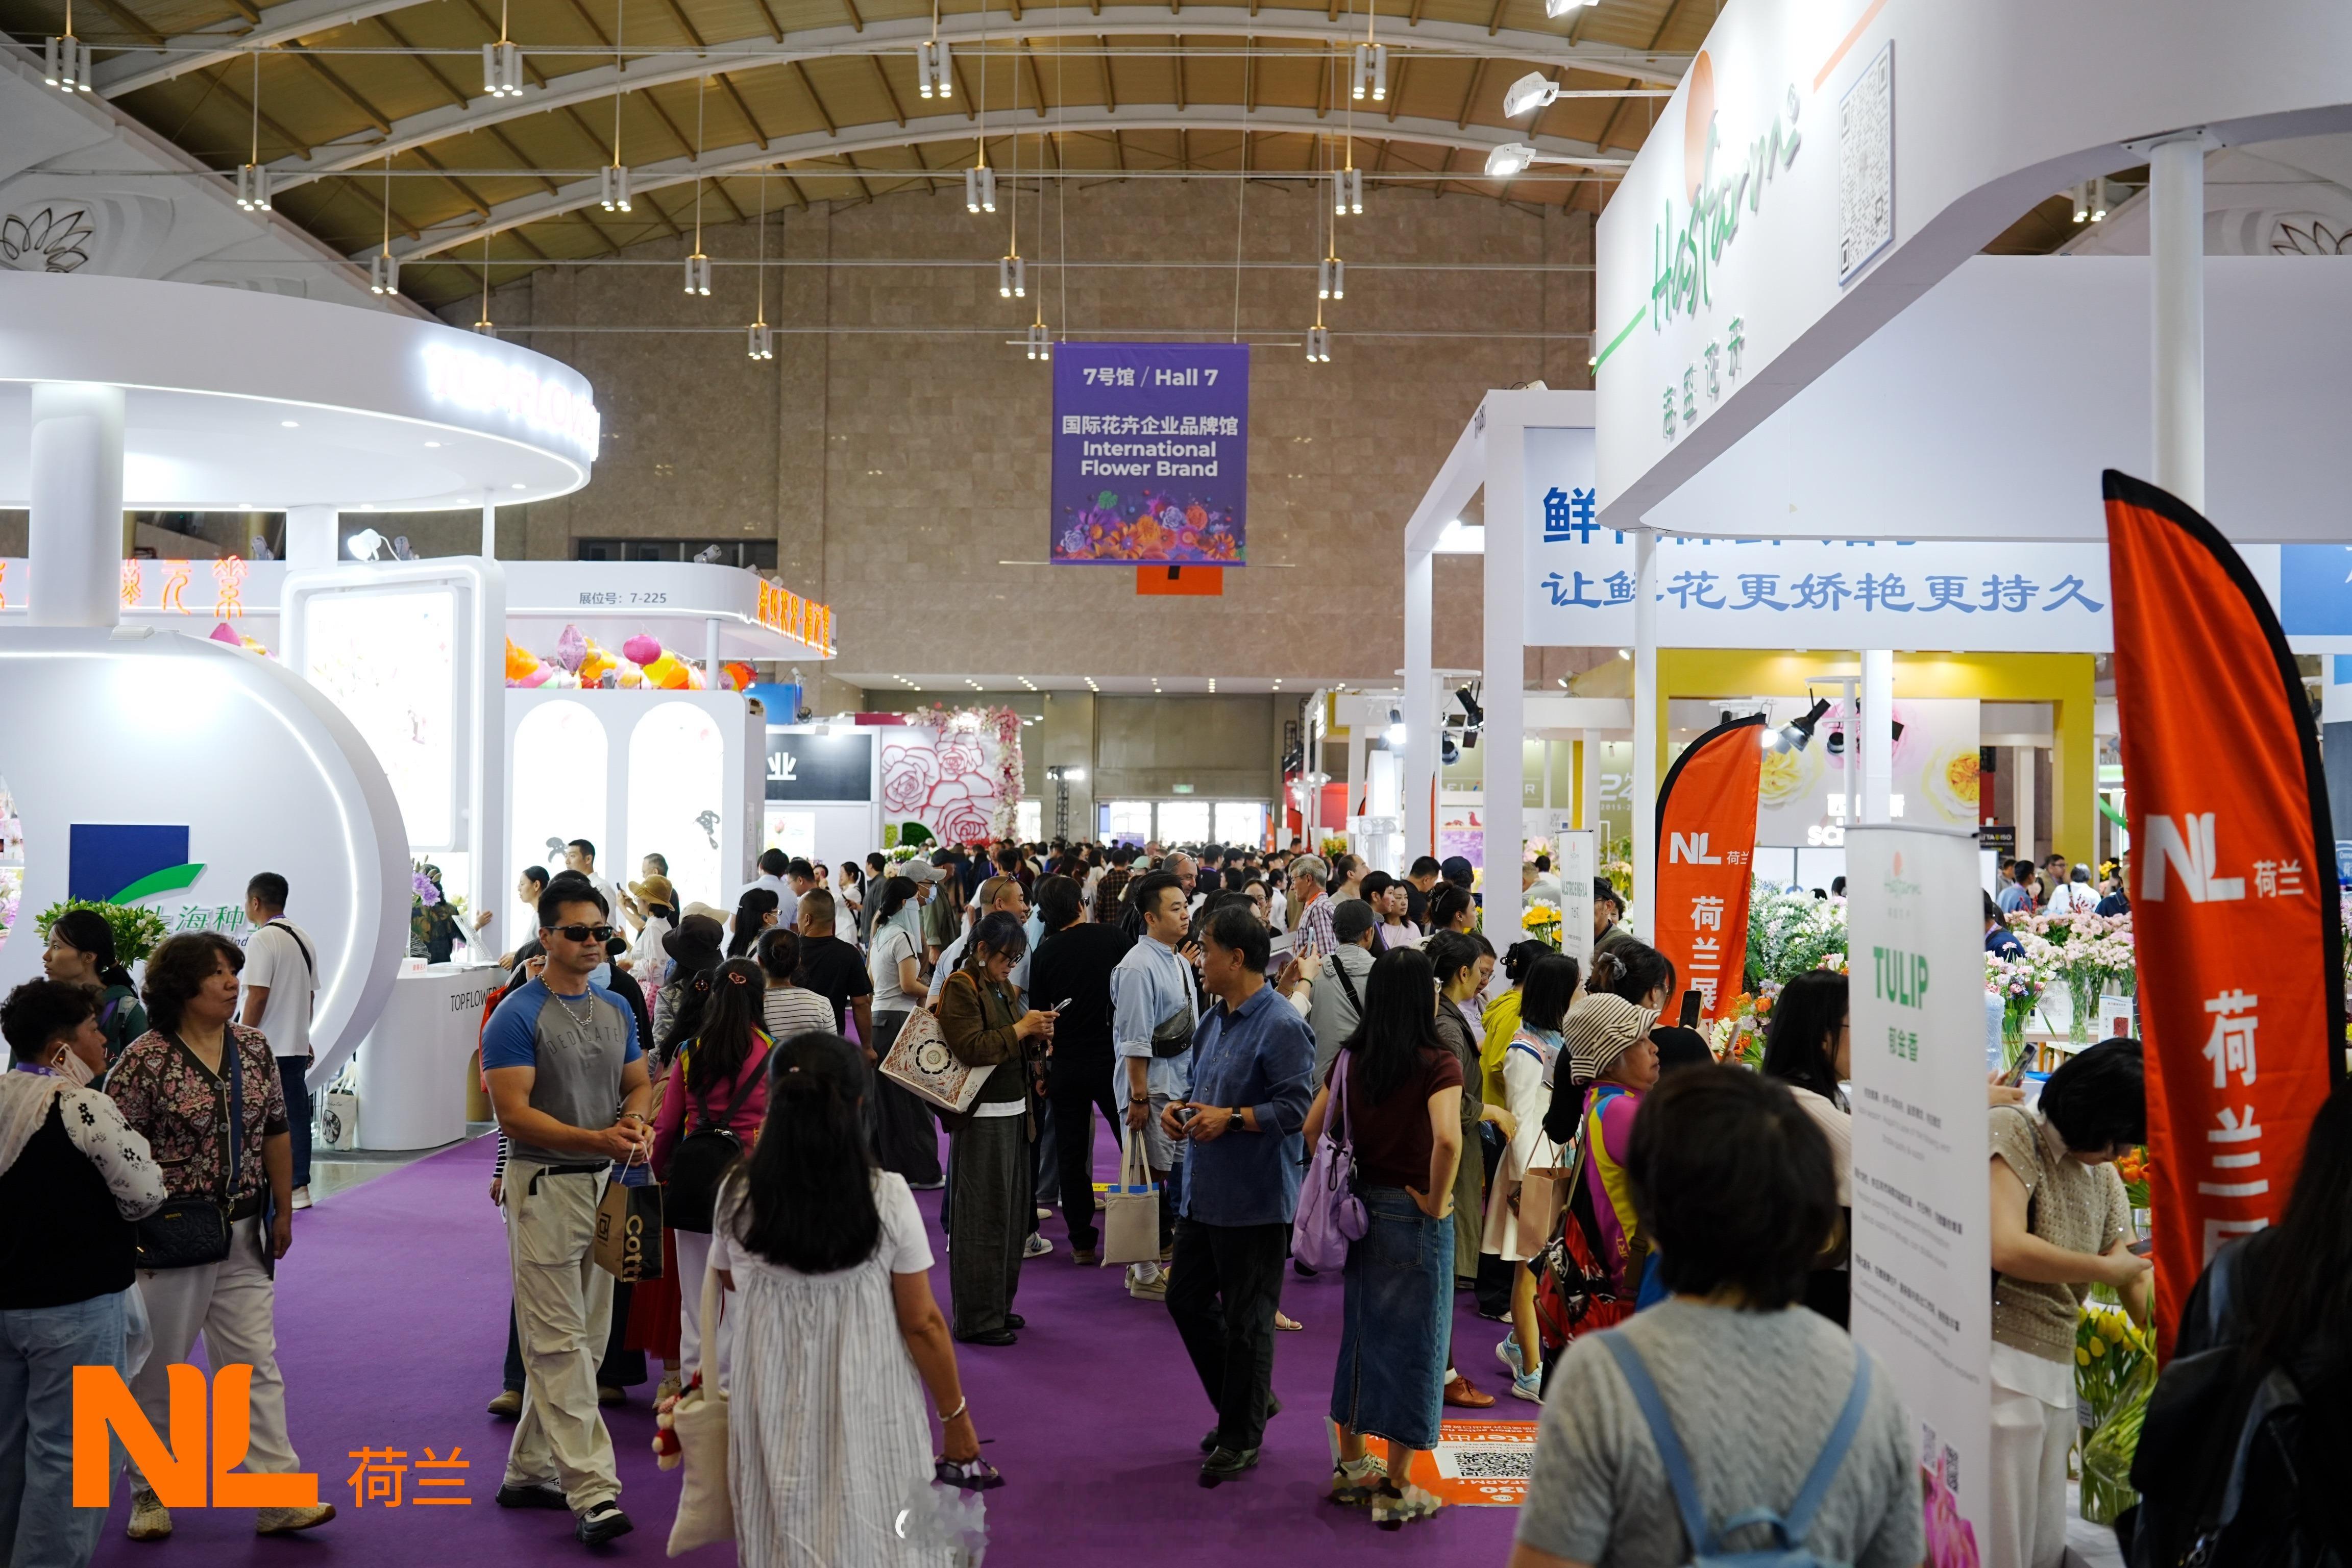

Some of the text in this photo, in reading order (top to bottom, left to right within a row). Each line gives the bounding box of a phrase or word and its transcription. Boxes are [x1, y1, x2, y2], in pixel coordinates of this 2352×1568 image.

[1083, 368, 1135, 386] 7号馆
[1155, 369, 1198, 386] Hall
[1204, 369, 1219, 386] 7
[1663, 314, 1743, 438] 海盛花卉
[1062, 415, 1239, 436] 国际花卉企业品牌馆
[1083, 440, 1217, 457] International
[1081, 460, 1218, 477] Flower Brand
[1540, 570, 2105, 614] 让鲜花更娇艳更持久
[1669, 832, 1749, 865] NL 荷兰
[2141, 812, 2304, 903] NL 荷兰
[1688, 896, 1724, 1034] 荷兰展
[1873, 946, 1929, 1010] TULIP
[546, 1027, 625, 1055] DEDICATE
